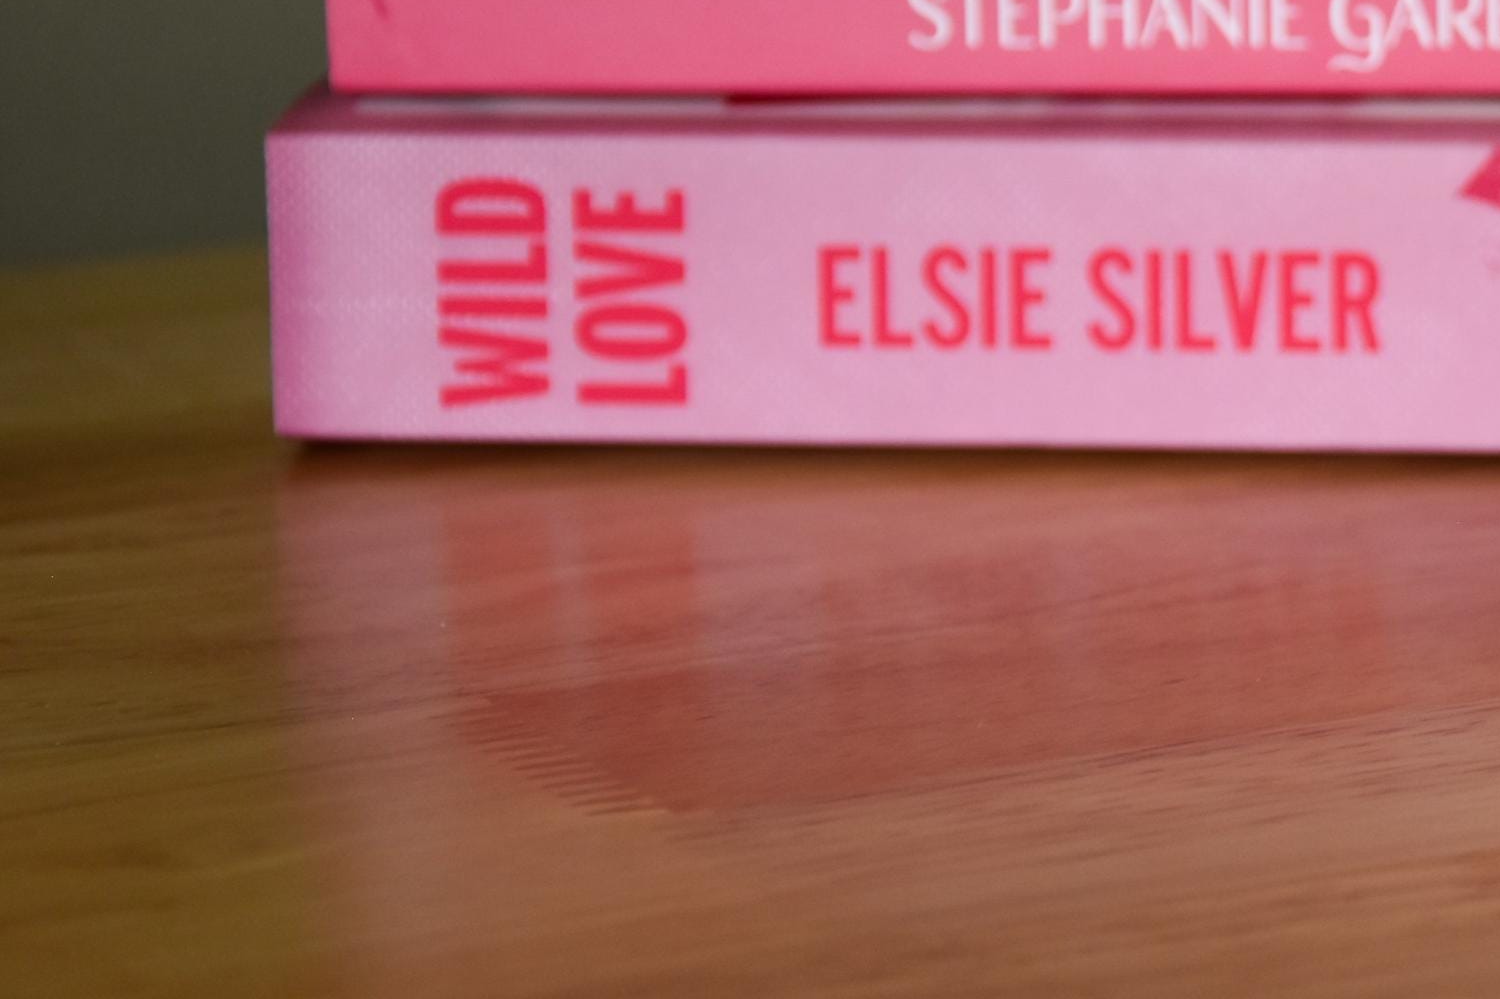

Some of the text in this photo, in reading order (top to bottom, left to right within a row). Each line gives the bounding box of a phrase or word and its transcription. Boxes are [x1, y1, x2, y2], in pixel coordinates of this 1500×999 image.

[436, 176, 550, 407] WILD
[573, 187, 687, 405] LOVE
[817, 243, 1382, 354] ELSIE SILVER
